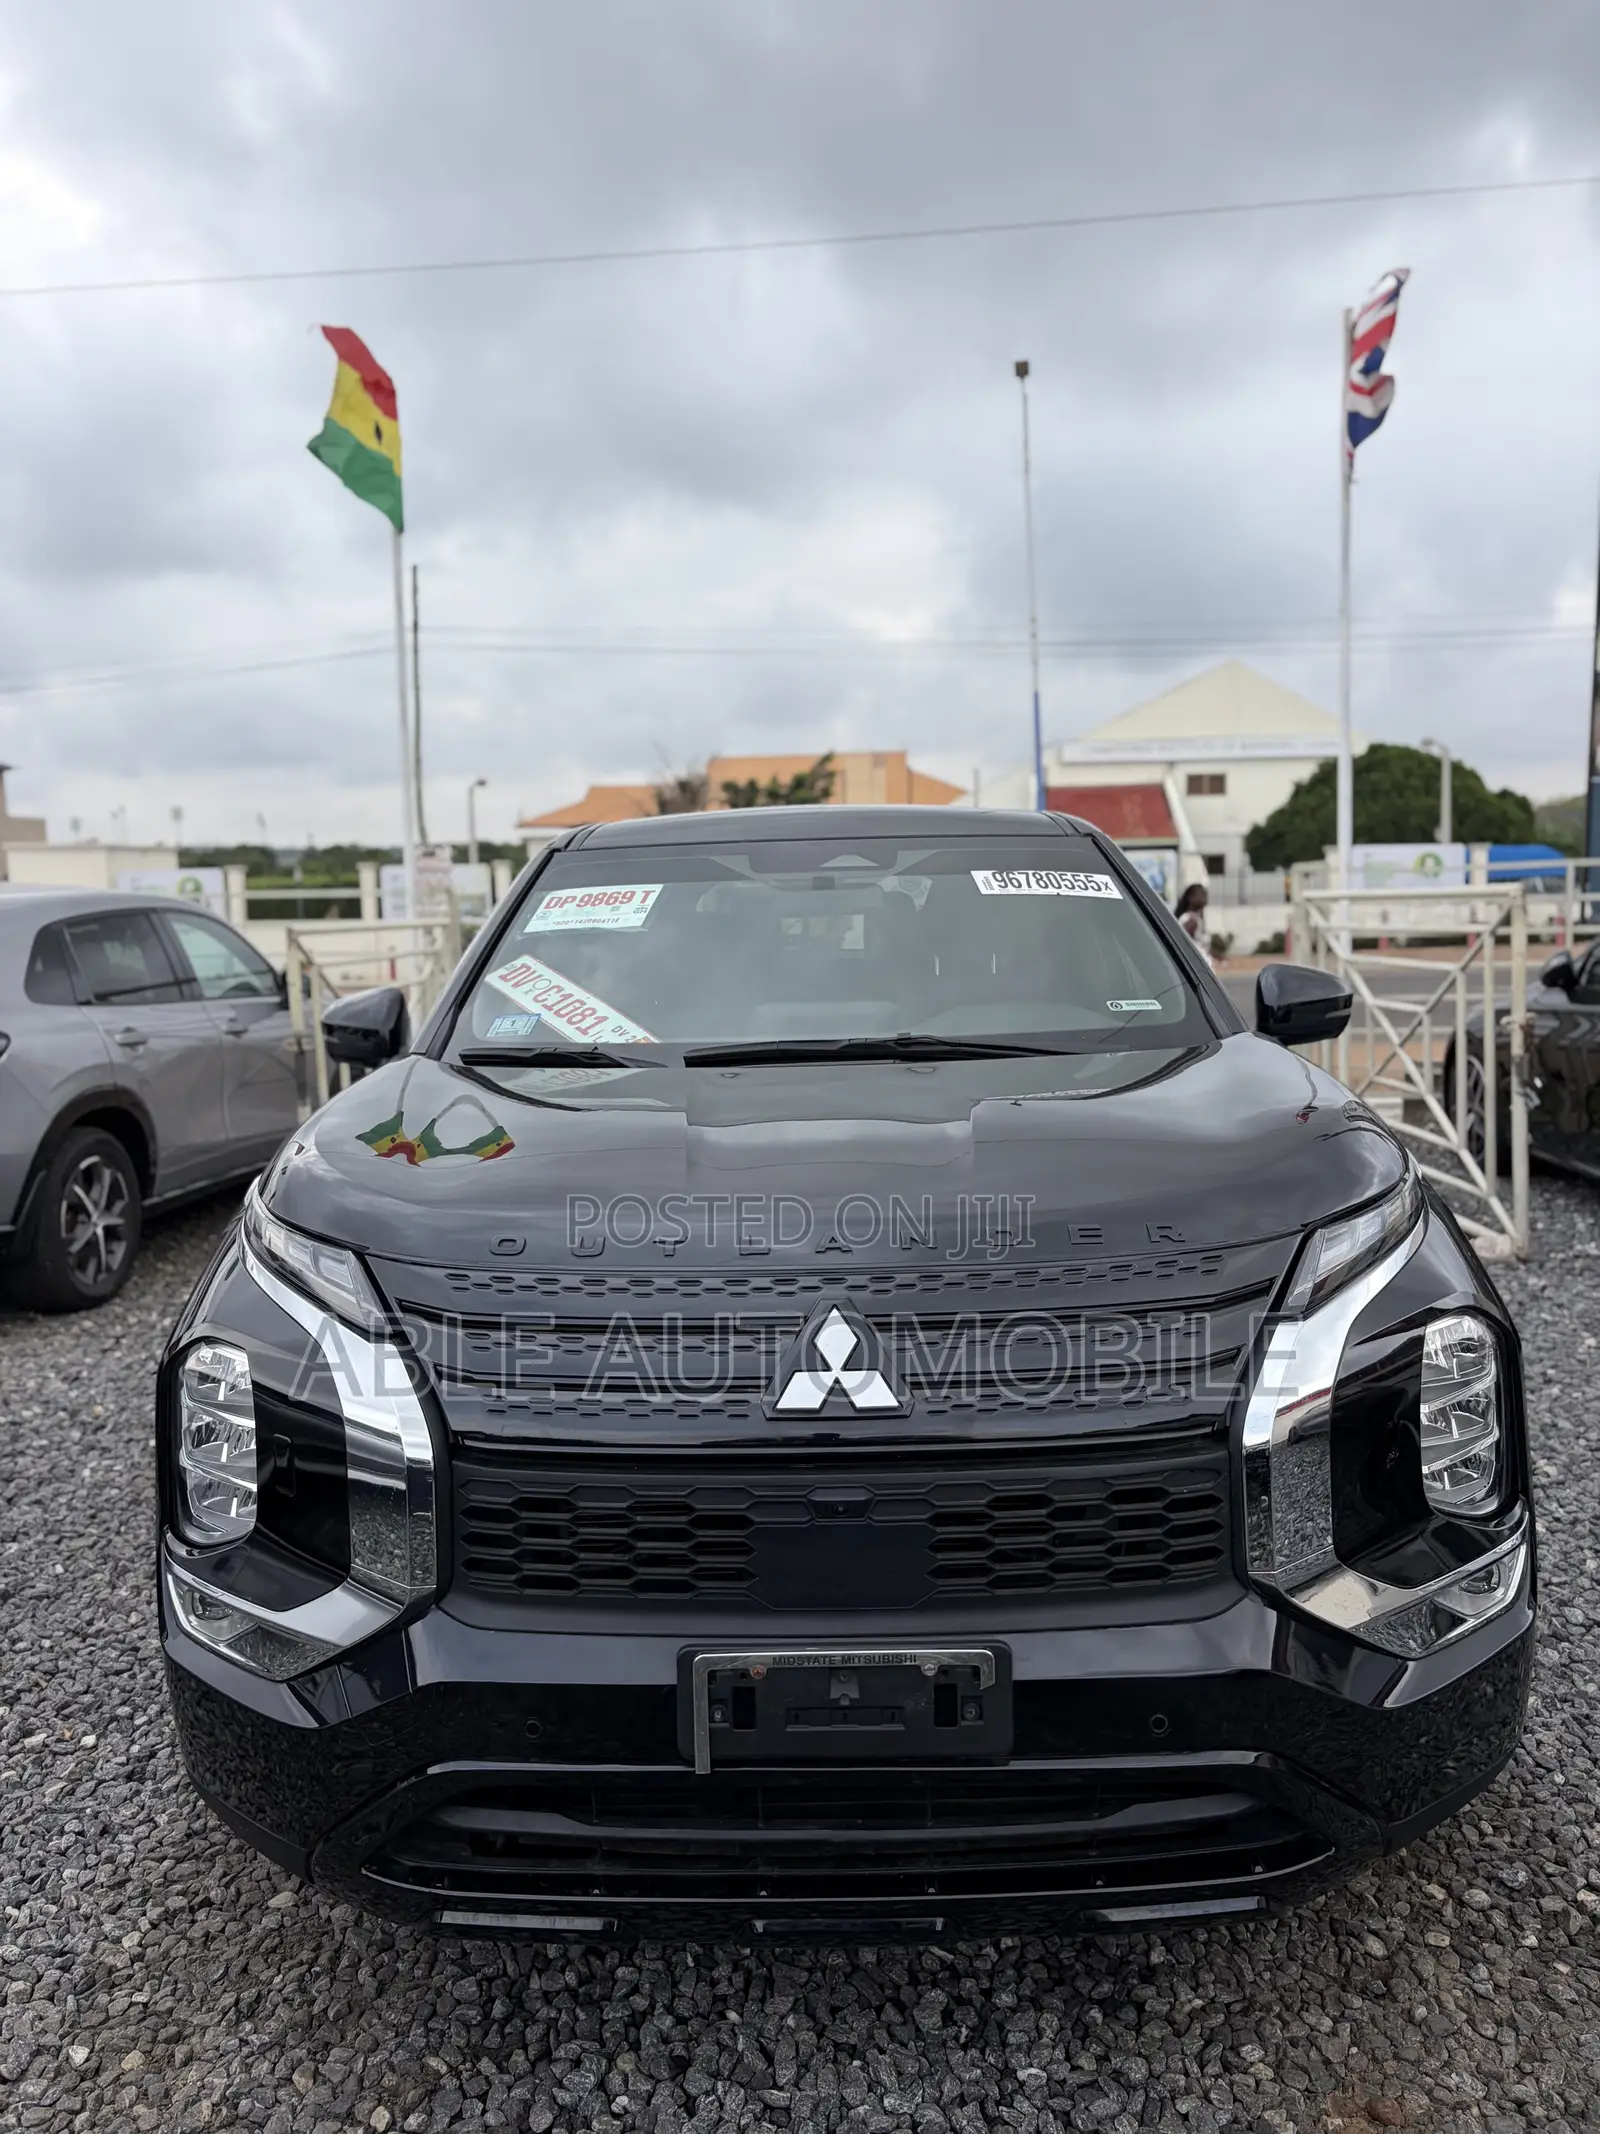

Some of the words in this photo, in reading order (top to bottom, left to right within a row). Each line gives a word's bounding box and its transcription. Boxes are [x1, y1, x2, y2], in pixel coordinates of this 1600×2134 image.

[488, 1222, 1186, 1257] OUTLANDER
[772, 1655, 837, 1667] MIDSTATE
[841, 1654, 917, 1665] MITSUBISHI
